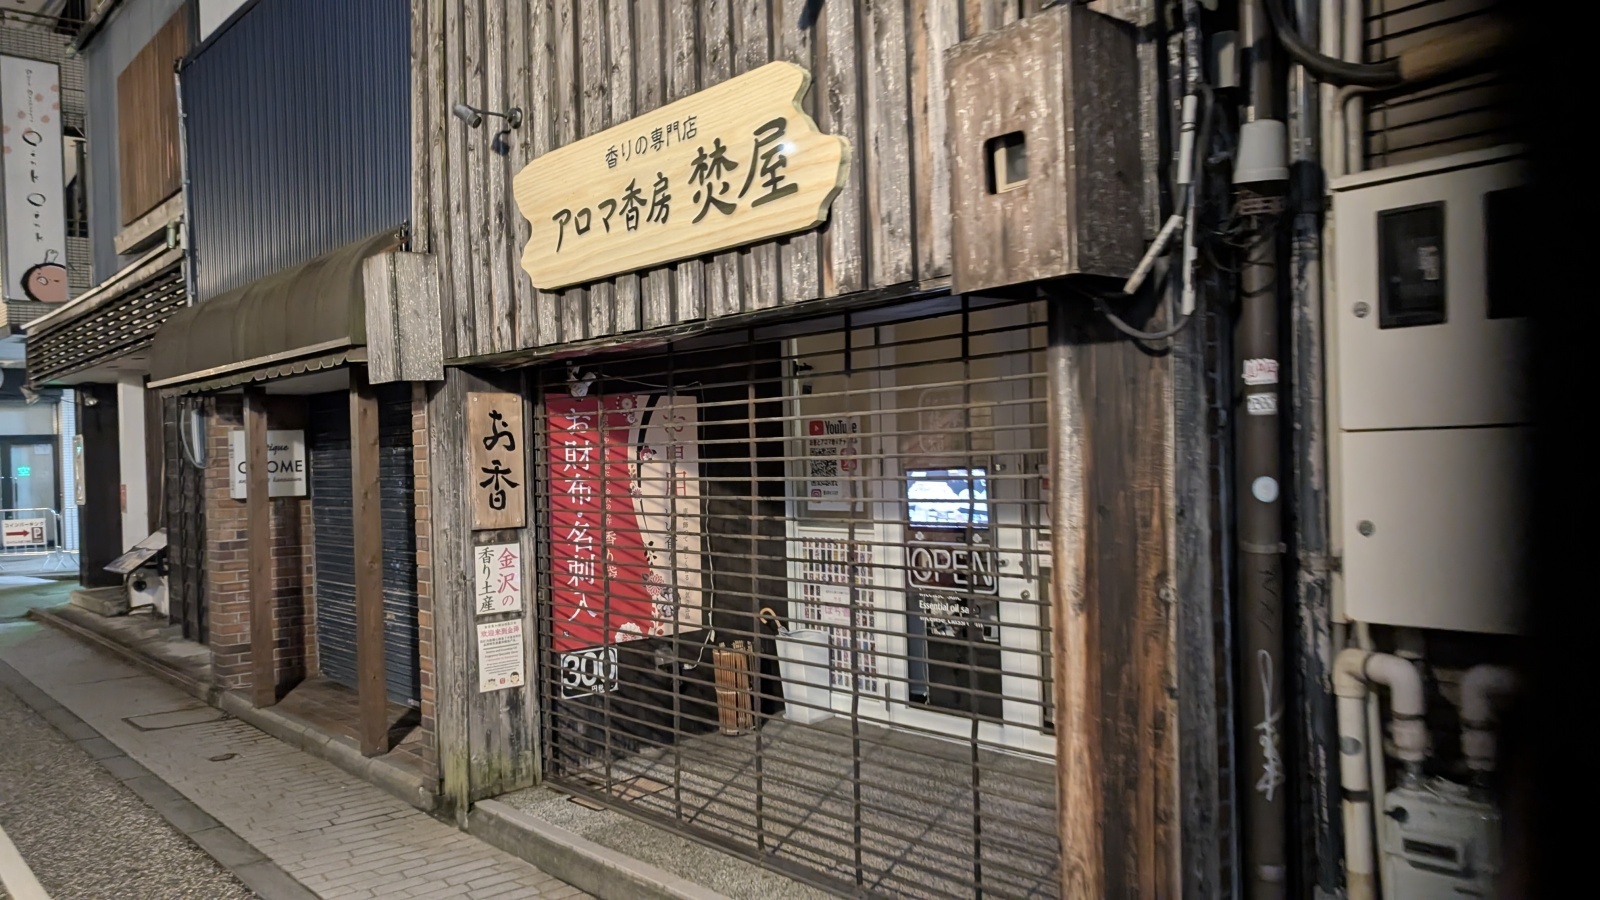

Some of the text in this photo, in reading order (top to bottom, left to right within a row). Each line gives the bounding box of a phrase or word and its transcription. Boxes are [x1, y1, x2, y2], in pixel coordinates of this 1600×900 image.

[605, 115, 699, 169] 香りの専門店
[552, 117, 798, 253] アロマ香房 焚屋
[824, 420, 857, 434] YouTue
[480, 410, 520, 511] お香
[478, 547, 496, 612] 香り土産
[497, 547, 519, 606] 金沢の
[911, 548, 993, 586] OPEN
[919, 600, 949, 614] Essential
[950, 603, 960, 614] oil
[563, 650, 616, 690] 300
